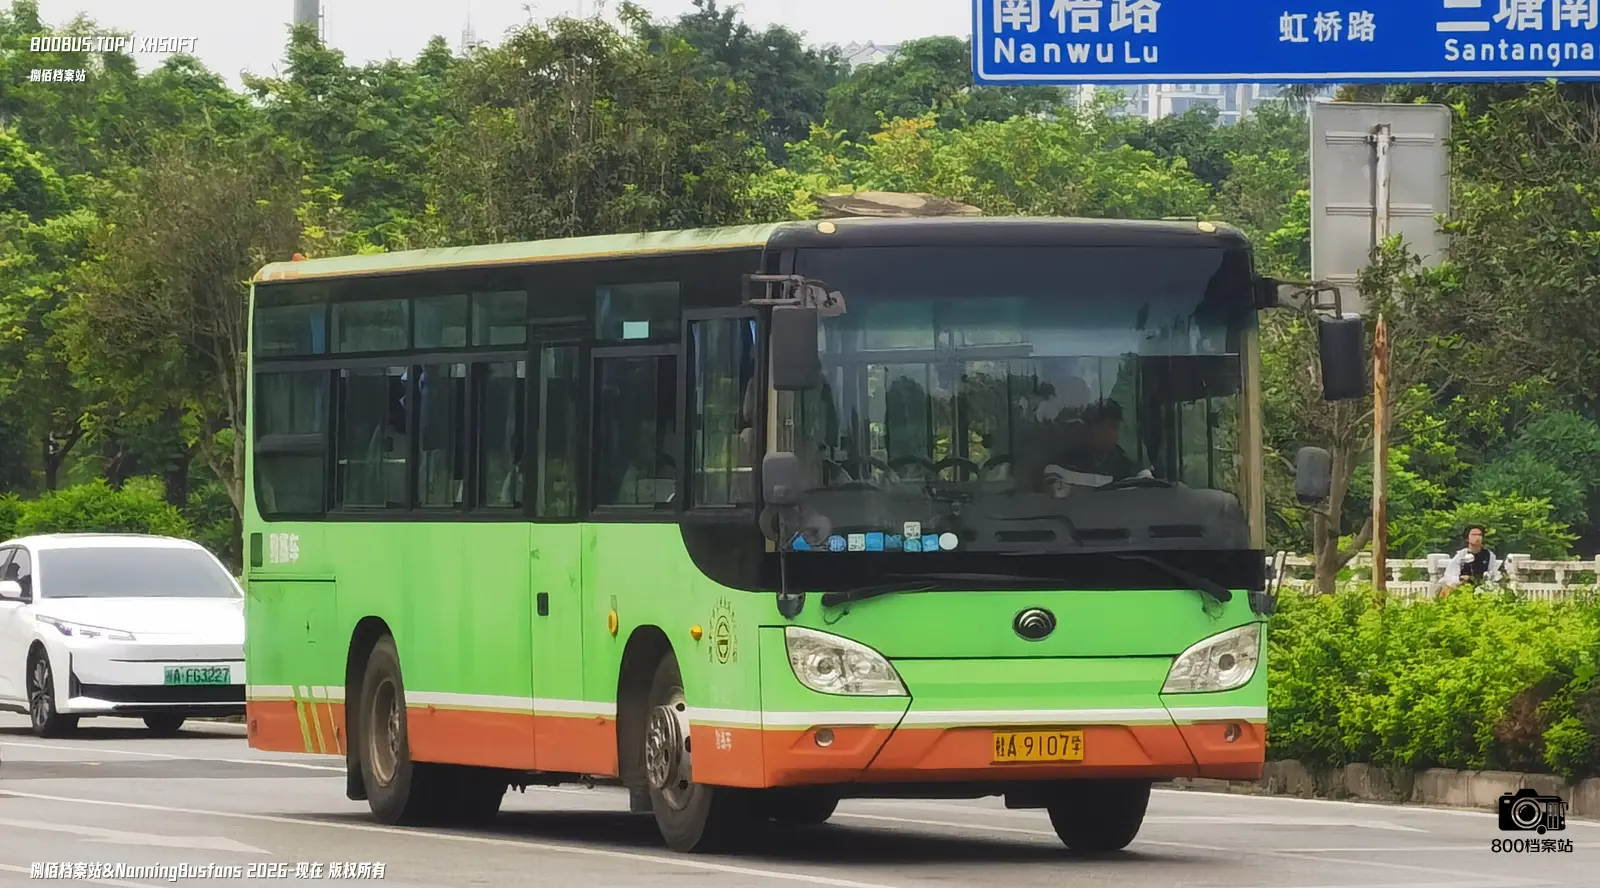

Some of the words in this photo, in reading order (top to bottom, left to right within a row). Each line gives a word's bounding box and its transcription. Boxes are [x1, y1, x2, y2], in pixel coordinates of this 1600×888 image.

[1279, 10, 1377, 43] 虹桥路
[994, 37, 1114, 64] Nanwu
[1124, 41, 1159, 64] Lu
[1444, 38, 1600, 68] Santangna
